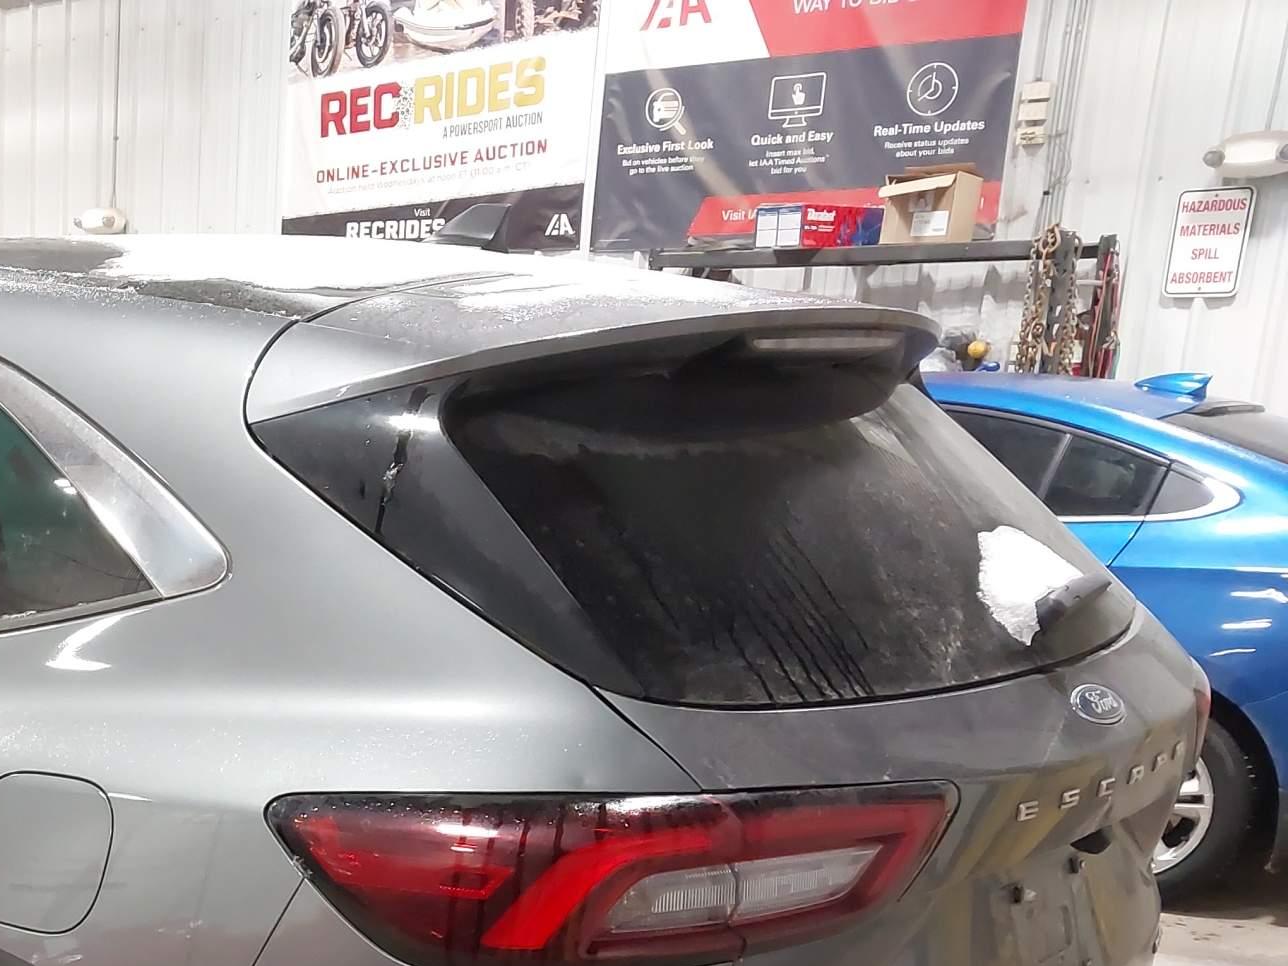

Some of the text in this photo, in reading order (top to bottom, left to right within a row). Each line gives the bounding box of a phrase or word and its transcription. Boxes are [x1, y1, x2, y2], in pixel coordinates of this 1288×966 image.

[443, 112, 544, 139] A POWERSPORT AUCTION
[873, 120, 985, 137] Real-Time Updates
[751, 130, 834, 146] Quick and Easy
[884, 137, 969, 149] Receive status updates
[617, 138, 714, 155] Exclusive First Look
[895, 148, 917, 158] about
[918, 148, 935, 158] your
[316, 139, 549, 184] ONLINE-EXCLUSIVE AUCTION
[641, 157, 667, 165] vehicles
[668, 156, 688, 164] before
[774, 157, 795, 166] Timed
[646, 165, 656, 173] the
[657, 164, 669, 172] live
[783, 166, 793, 174] for
[794, 166, 808, 174] you
[1181, 198, 1248, 213] HAZARDOUS
[414, 208, 431, 217] Visit
[722, 208, 746, 221] Visit
[345, 218, 446, 240] RECRIDES
[1179, 222, 1241, 237] MATERIALS
[1191, 248, 1219, 260] SPILL
[1170, 271, 1234, 284] ABSORBENT
[1085, 689, 1120, 714] Ford
